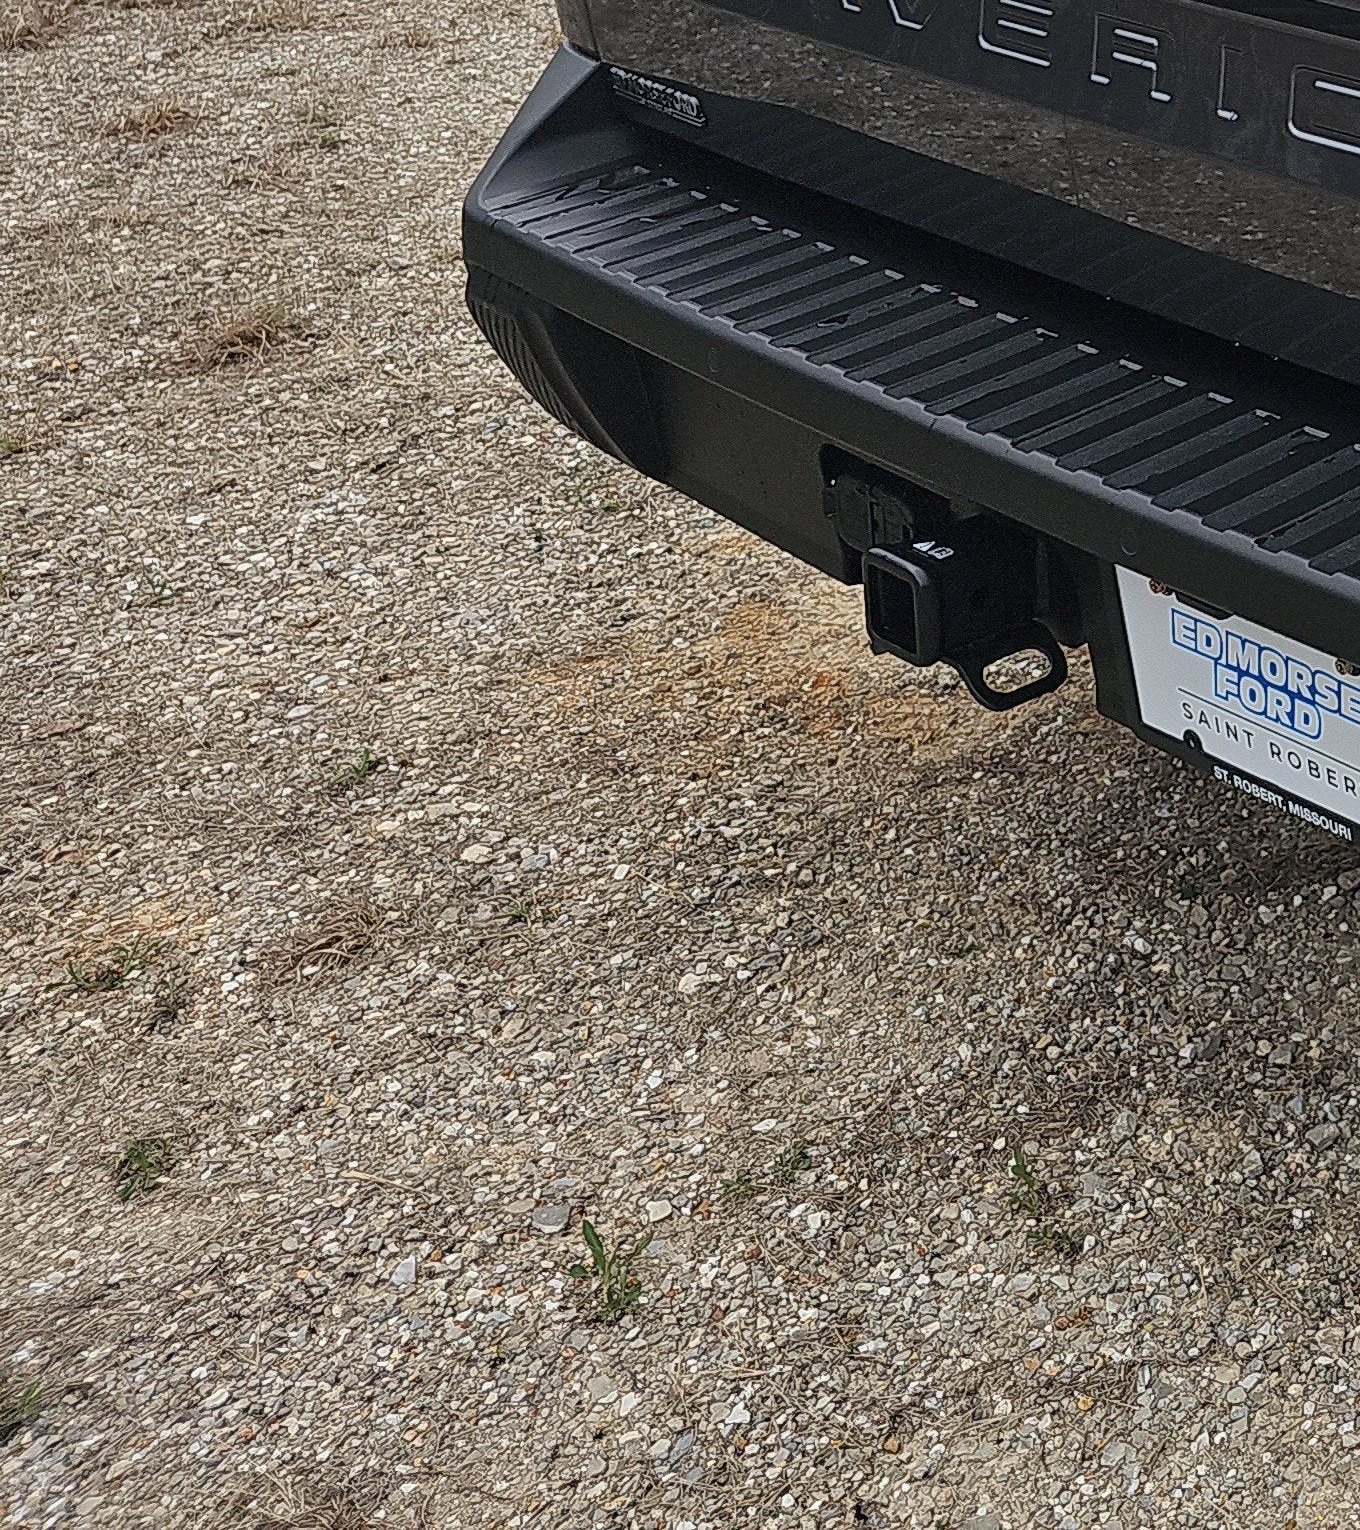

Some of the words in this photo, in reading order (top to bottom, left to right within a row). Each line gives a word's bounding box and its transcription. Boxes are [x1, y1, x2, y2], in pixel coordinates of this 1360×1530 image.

[1170, 608, 1222, 660] ED
[1181, 702, 1255, 750] SAINT
[1214, 660, 1322, 740] FORD
[1213, 765, 1233, 786] ST.
[1234, 773, 1287, 813] ROBERT,
[1288, 800, 1353, 841] MISSOURI
